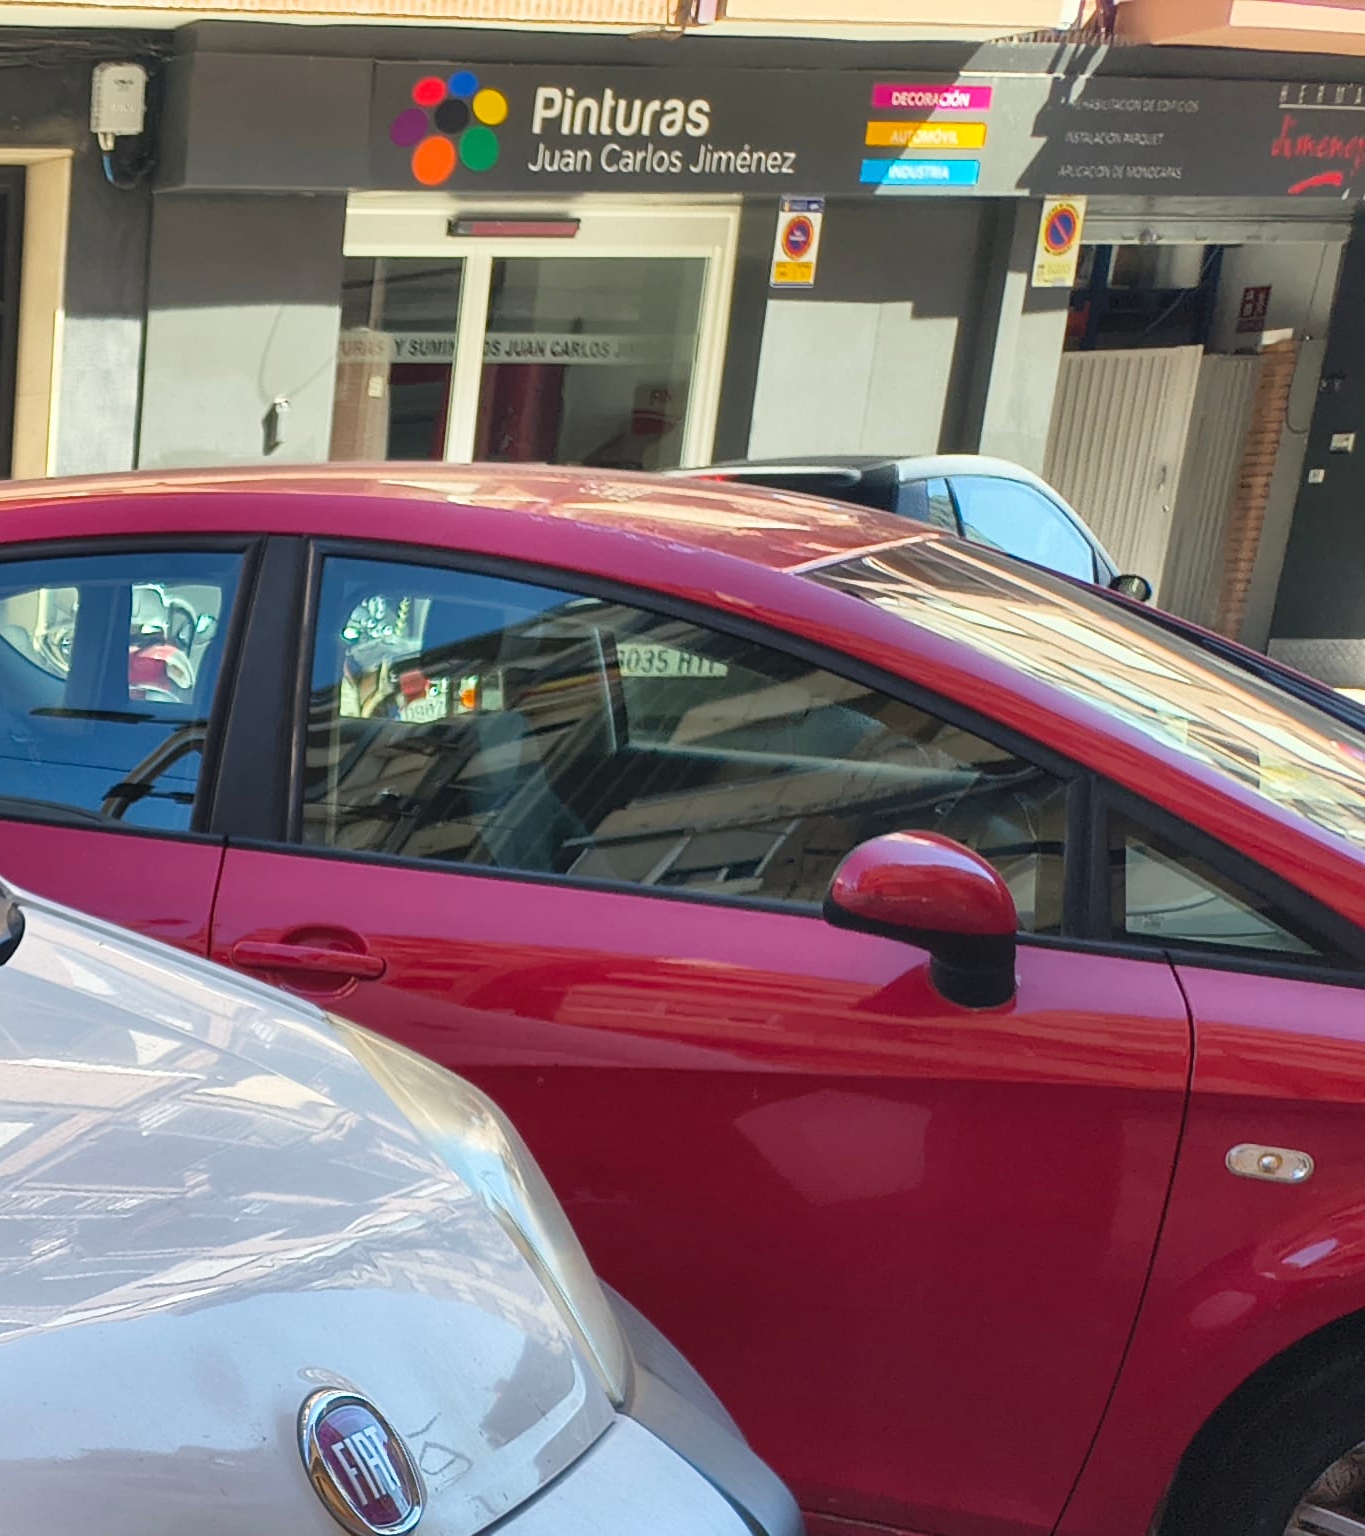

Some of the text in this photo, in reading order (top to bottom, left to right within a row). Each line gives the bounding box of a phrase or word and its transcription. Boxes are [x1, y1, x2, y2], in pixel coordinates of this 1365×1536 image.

[532, 86, 711, 137] Pinturas
[891, 90, 971, 107] DECORACIÓN
[527, 143, 796, 174] Juan Carlos Jiménez
[504, 339, 546, 358] JUAN
[550, 340, 612, 359] CARLOS
[331, 1425, 401, 1505] FIAT
